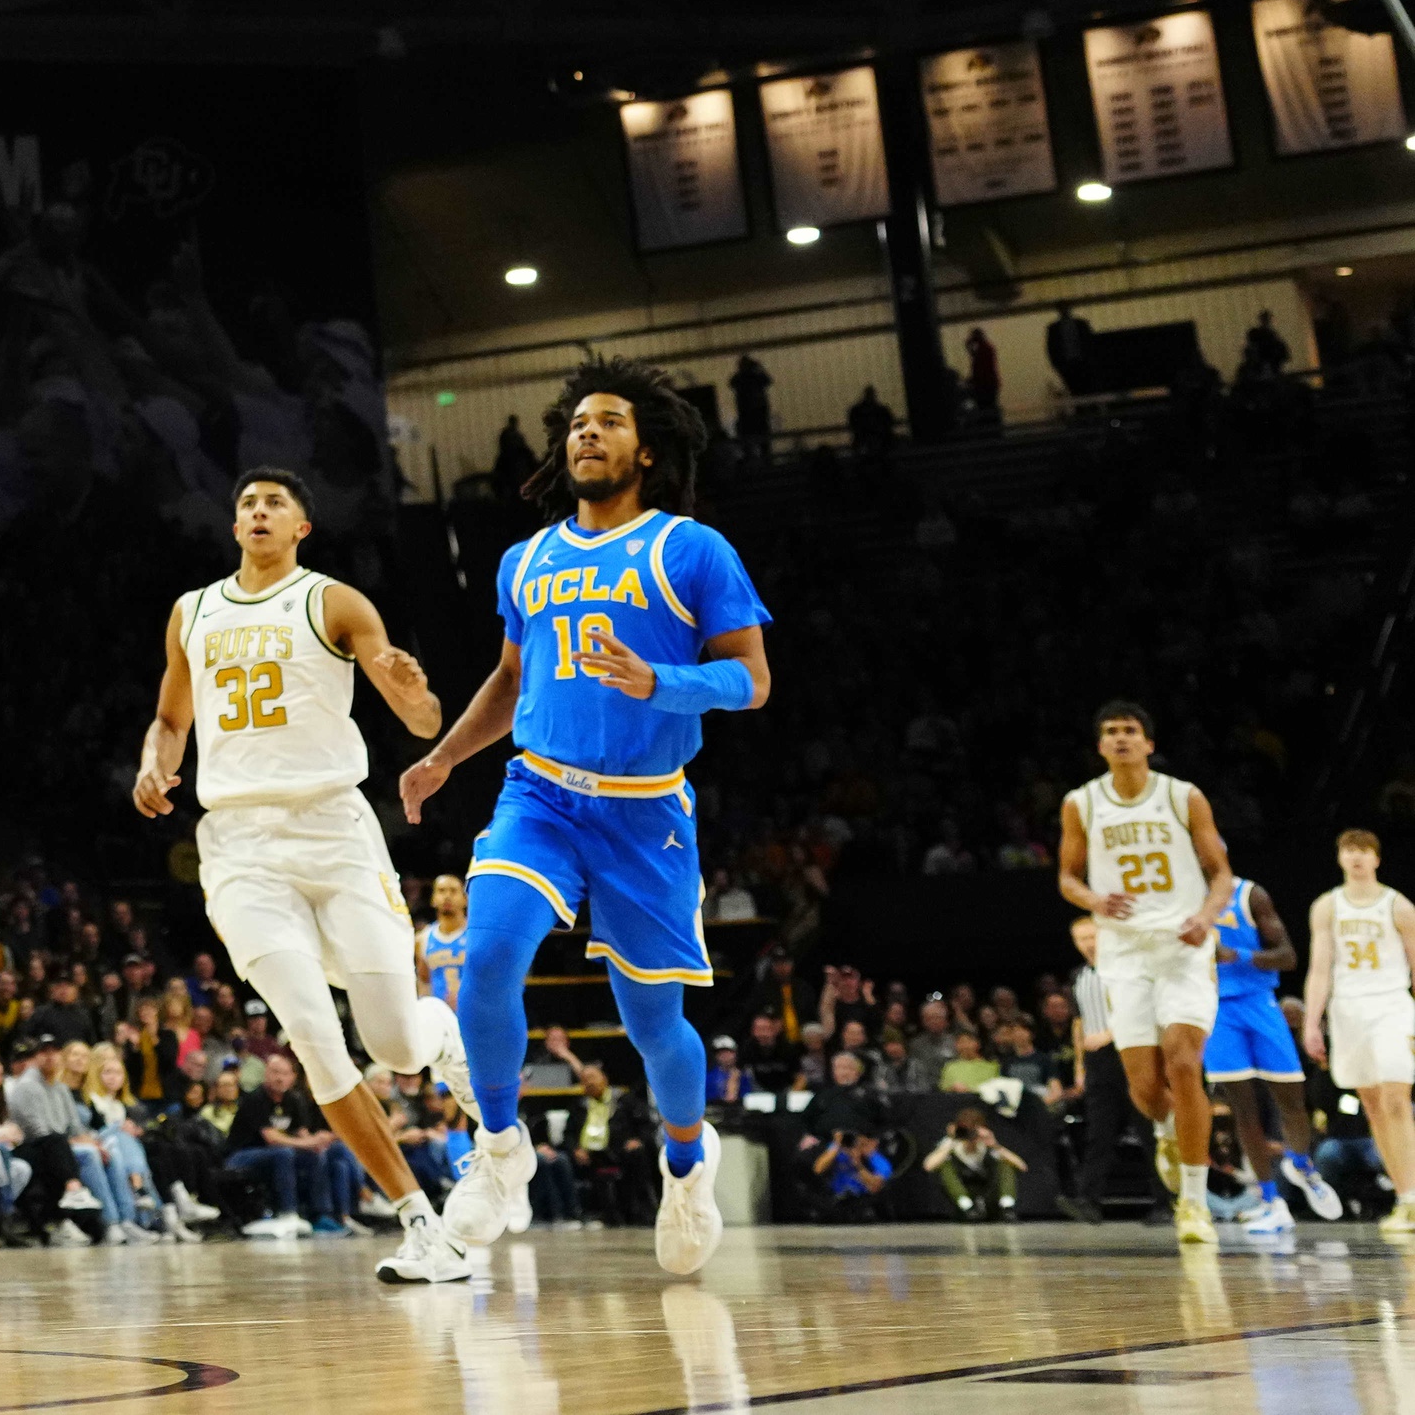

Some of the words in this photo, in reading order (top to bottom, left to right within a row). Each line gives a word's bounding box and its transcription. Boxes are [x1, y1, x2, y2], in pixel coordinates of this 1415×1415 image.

[524, 567, 649, 615] UCLA
[204, 625, 292, 668] BUFFS
[215, 661, 288, 732] 32
[1101, 821, 1173, 851] BUFFS
[1117, 851, 1174, 894] 23
[1345, 941, 1380, 970] 34
